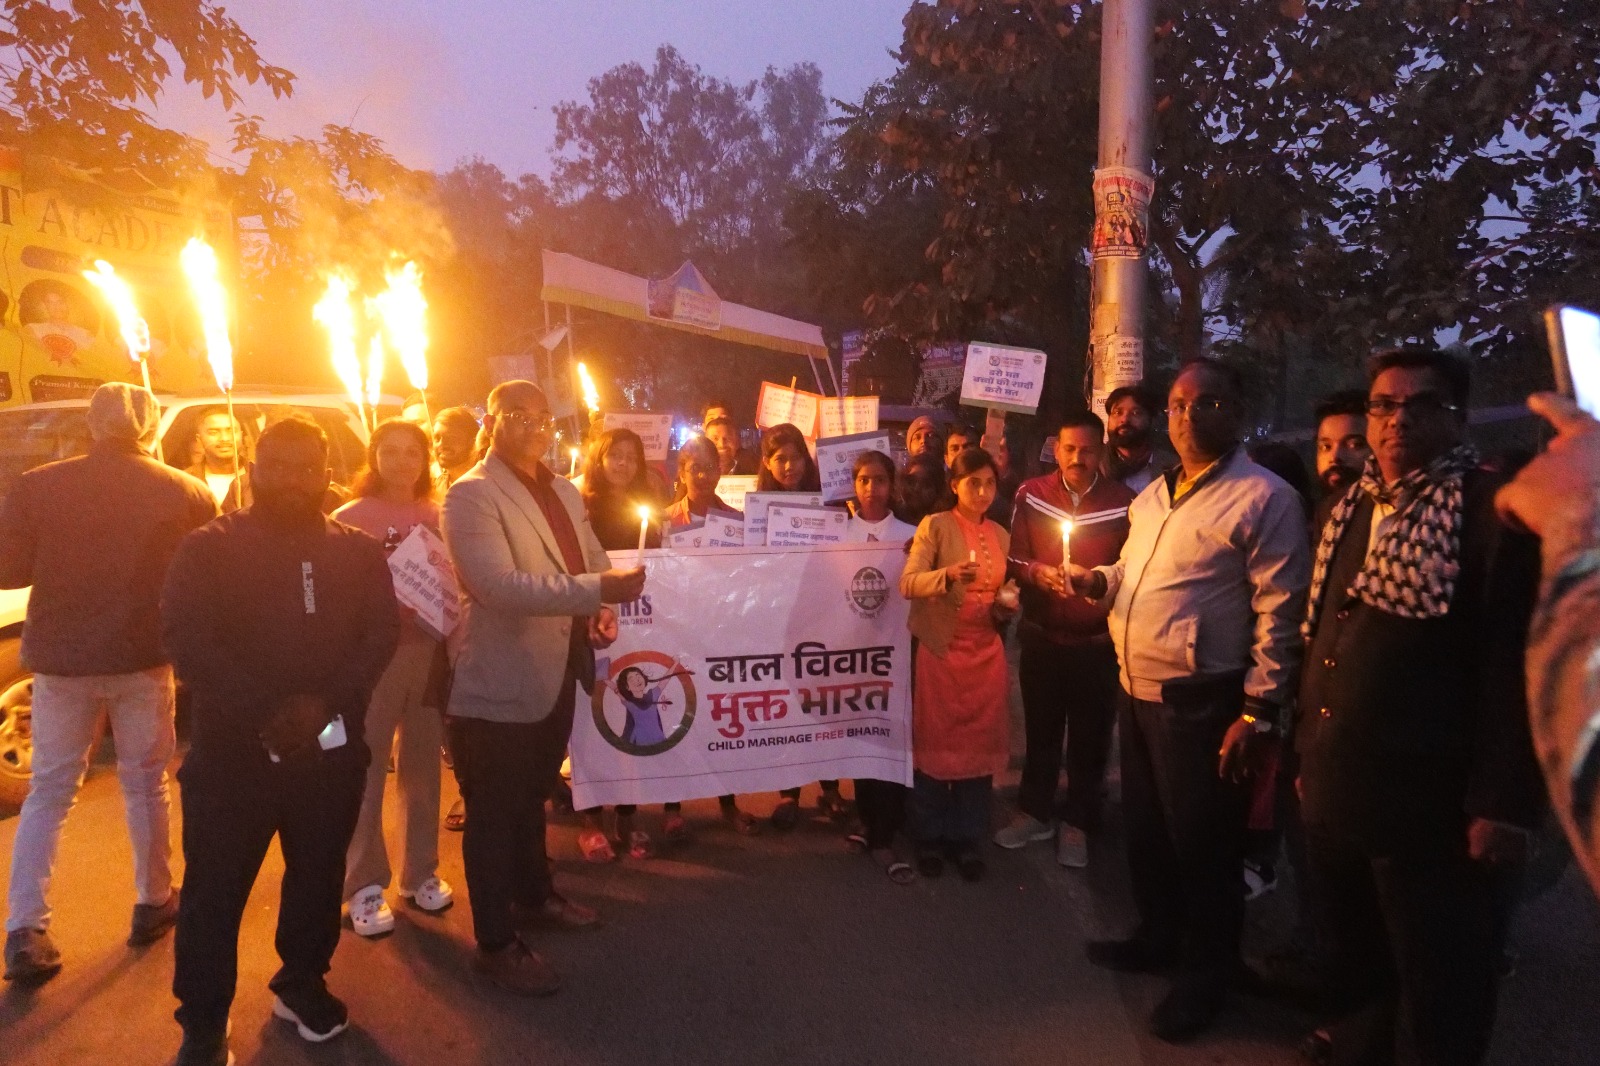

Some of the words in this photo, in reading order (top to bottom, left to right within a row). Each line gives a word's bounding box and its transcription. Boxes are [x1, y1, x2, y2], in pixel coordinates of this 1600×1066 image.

[705, 653, 784, 684] बाल
[791, 640, 895, 681] विवाह
[707, 688, 790, 738] मुक्त
[796, 680, 894, 716] भारत
[707, 738, 745, 753] CHILD
[747, 731, 812, 749] MARRIAGE
[814, 729, 844, 742] FREE
[846, 726, 891, 741] BHARAT
